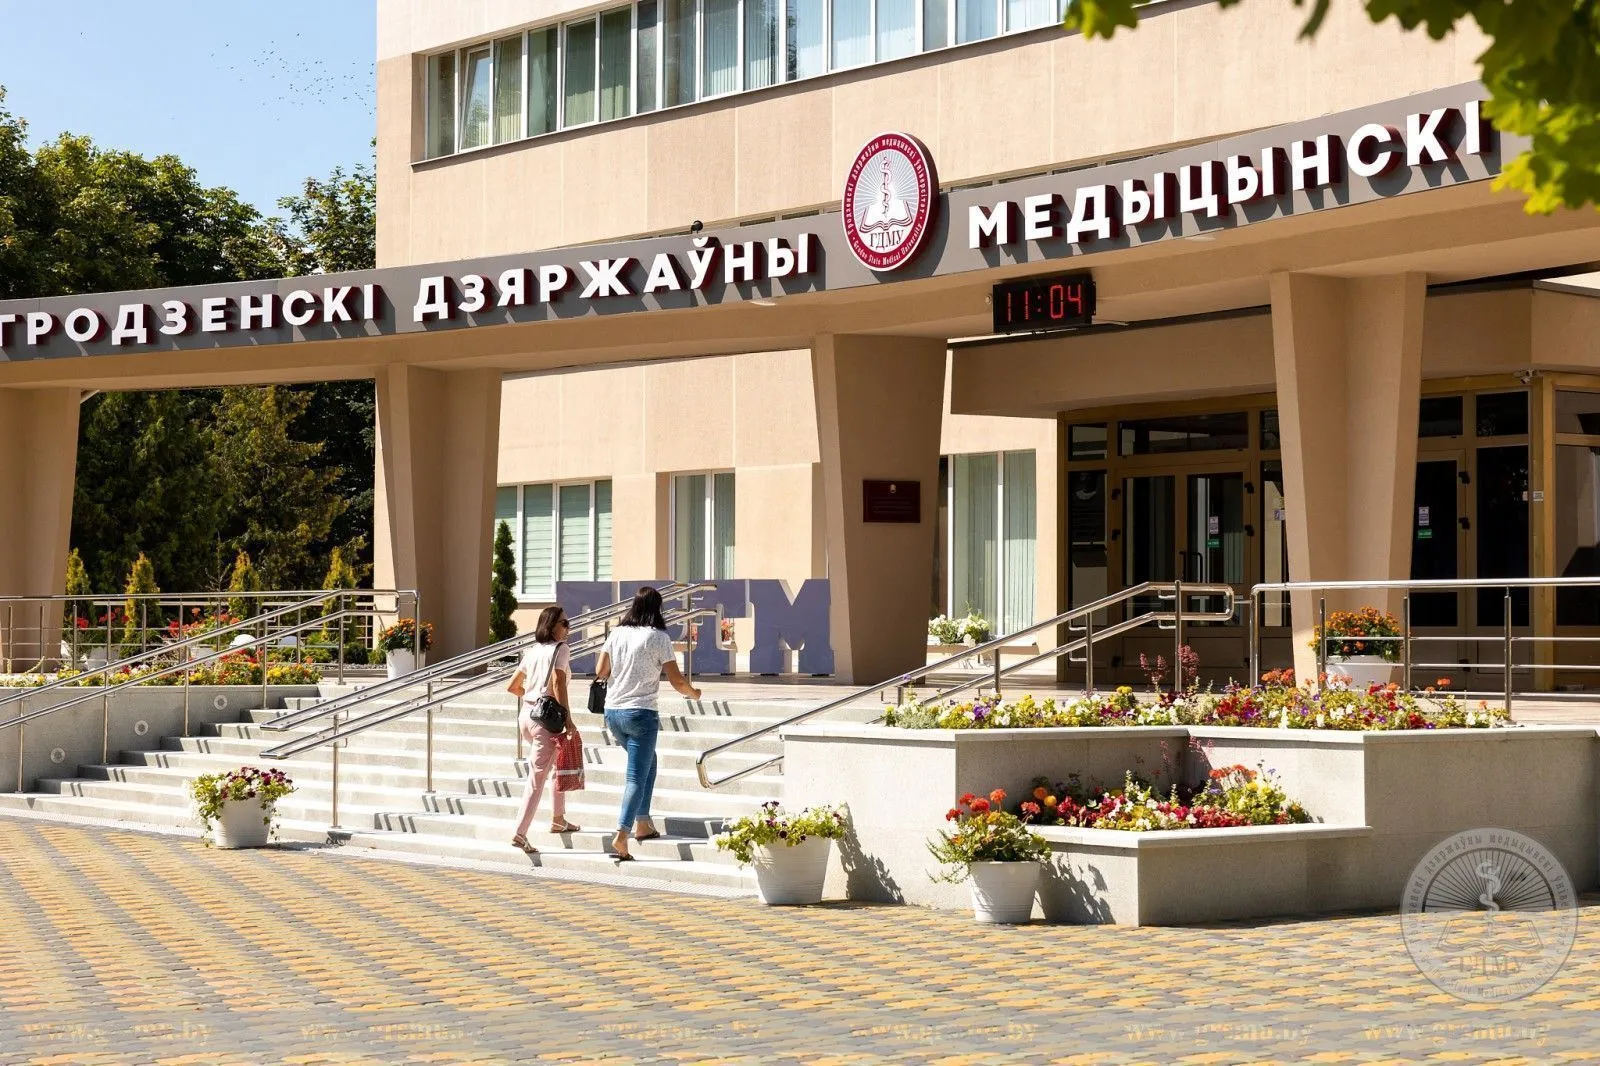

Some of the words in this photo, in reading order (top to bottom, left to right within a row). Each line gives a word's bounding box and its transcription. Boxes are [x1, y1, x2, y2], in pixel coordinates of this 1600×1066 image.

[413, 232, 811, 322] ДЗЯРЖАЎНЫ
[968, 99, 1482, 249] МЕДЫЦЫНСКІ
[870, 230, 904, 250] ГДМУ
[882, 253, 901, 266] Medical
[1007, 284, 1082, 322] 11:04
